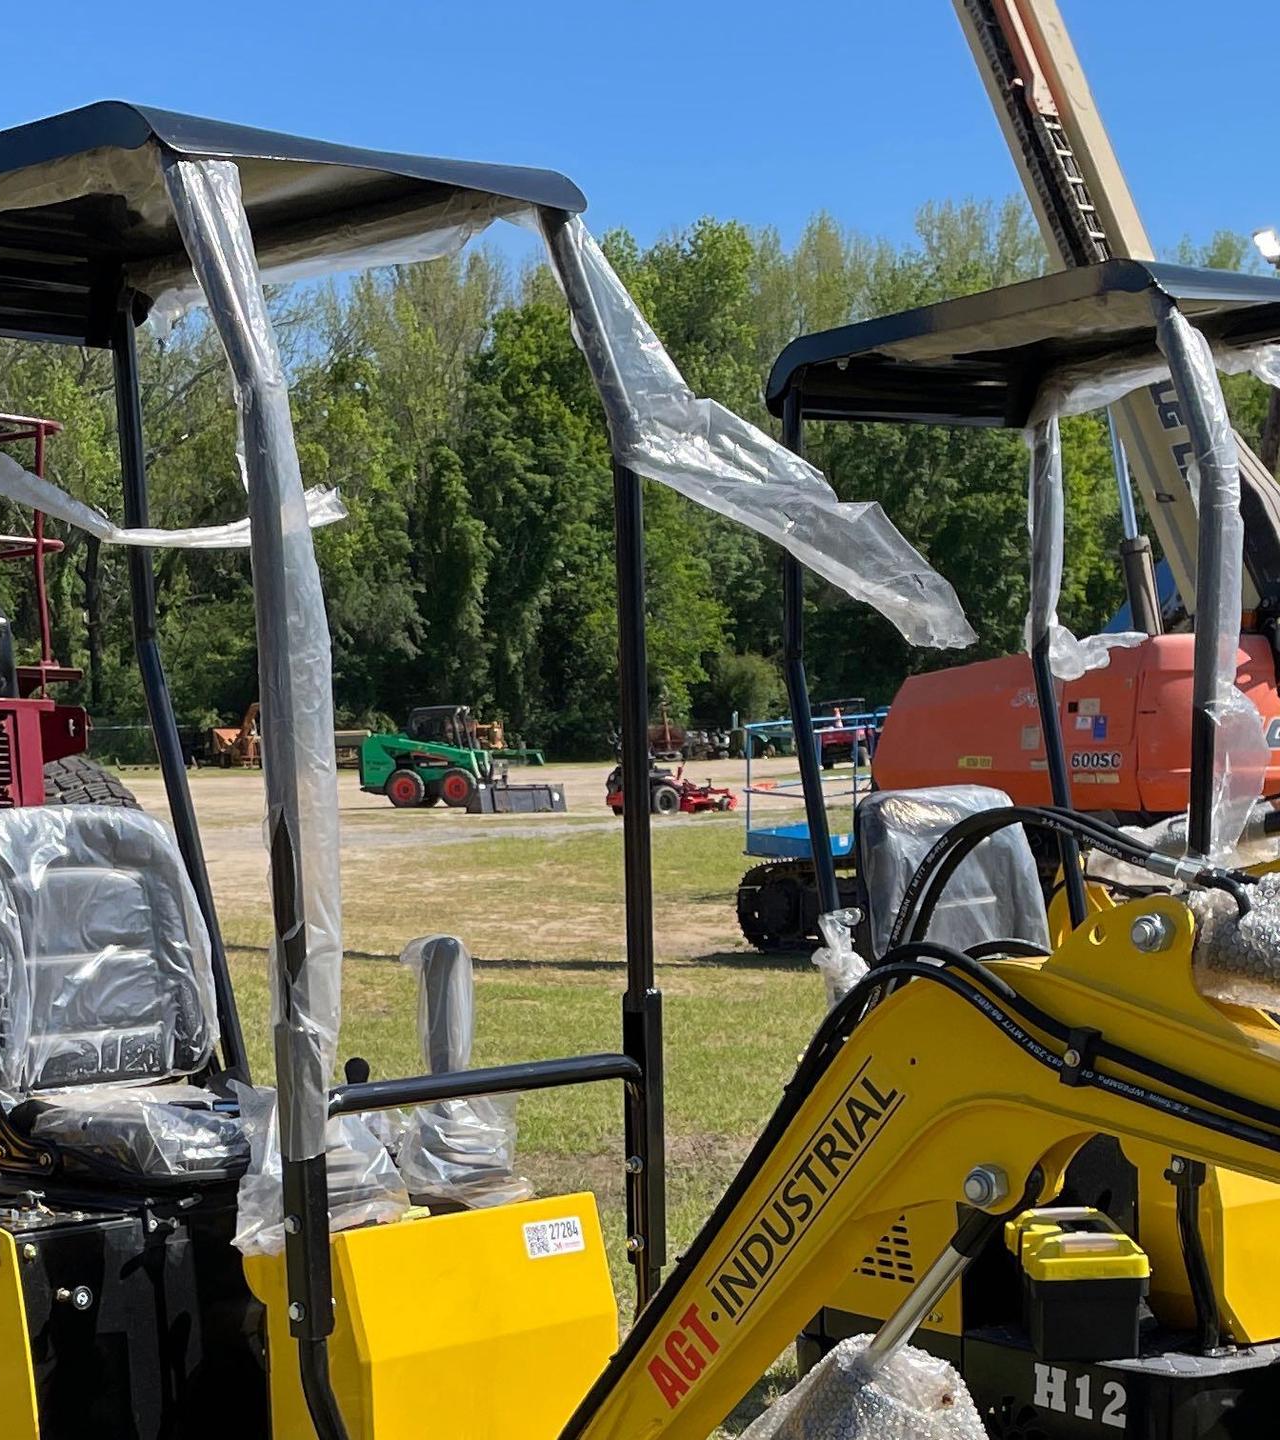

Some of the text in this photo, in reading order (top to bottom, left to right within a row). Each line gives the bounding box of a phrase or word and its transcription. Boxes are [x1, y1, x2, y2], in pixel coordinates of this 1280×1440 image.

[548, 1219, 579, 1240] 27284
[647, 1076, 898, 1410] AGT INDUSTRIAL
[1033, 1361, 1127, 1429] H12
